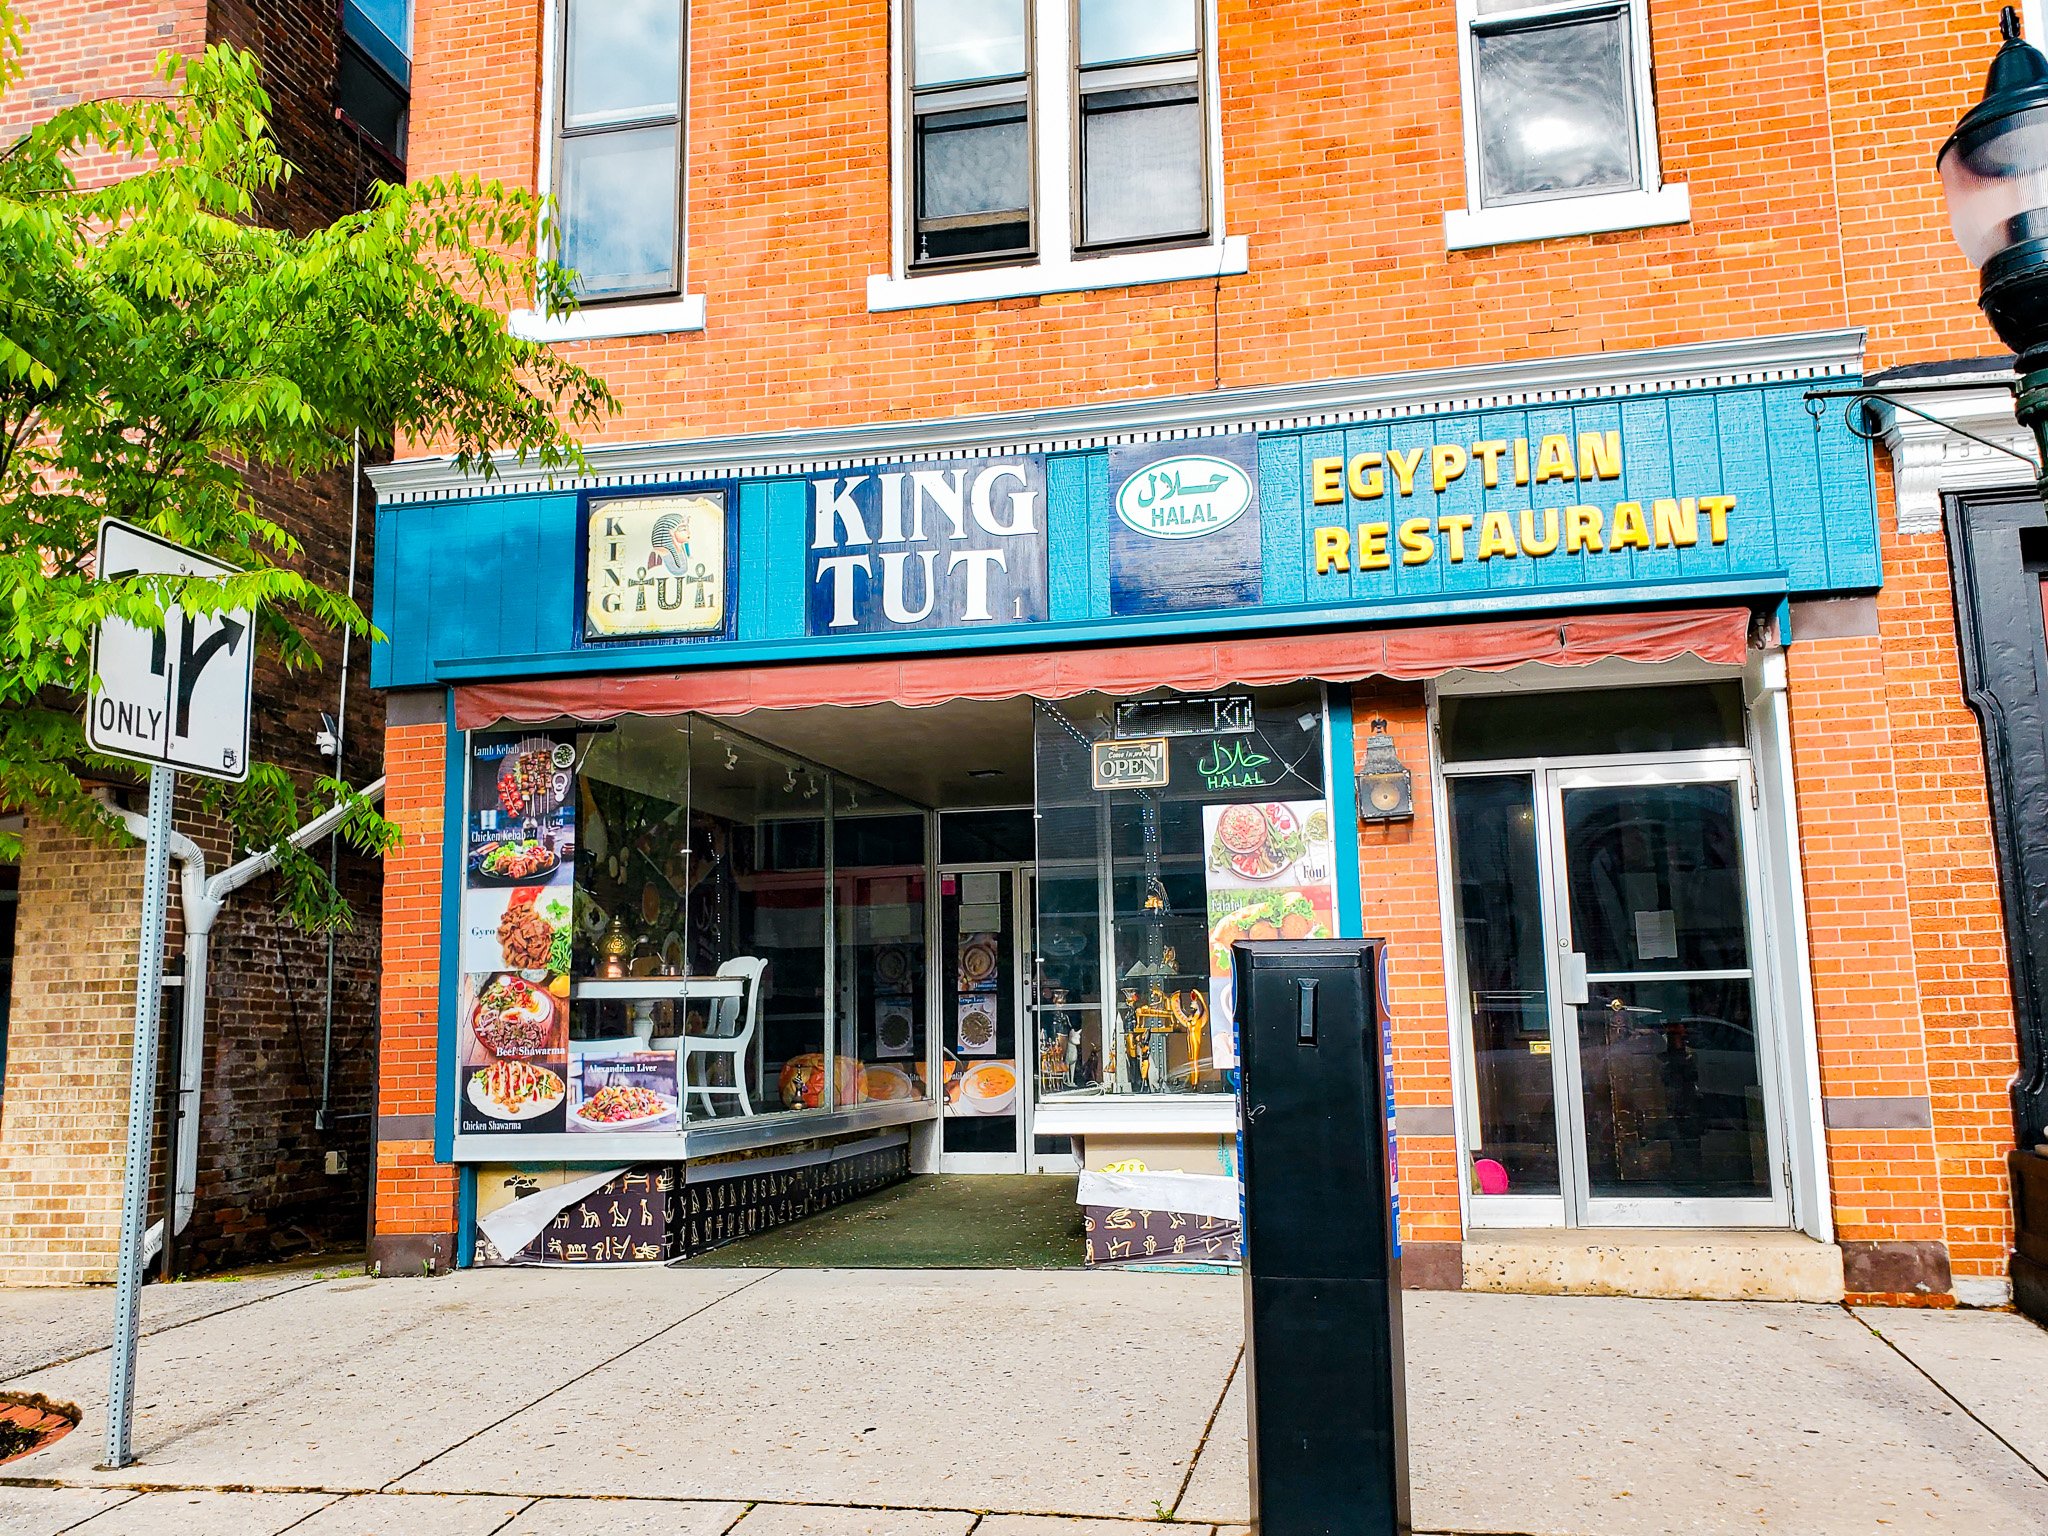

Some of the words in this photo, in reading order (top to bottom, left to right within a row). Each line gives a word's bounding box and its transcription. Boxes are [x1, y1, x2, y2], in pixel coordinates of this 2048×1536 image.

[1311, 430, 1622, 505] EGYPTIAN
[1138, 470, 1229, 508] حلال
[811, 464, 1039, 549] KING
[1151, 503, 1218, 527] HALAL
[1314, 495, 1736, 574] RESTAURANT
[601, 516, 626, 613] KING
[628, 562, 714, 612] TUT
[816, 549, 1010, 627] TUT
[1012, 596, 1023, 620] 1
[100, 697, 162, 741] ONLY
[474, 744, 494, 756] Lamb
[496, 743, 520, 755] Kebab
[1199, 740, 1268, 775] حلال
[1100, 757, 1159, 778] OPEN
[1207, 772, 1262, 789] HALAL
[471, 830, 501, 842] Chicken
[502, 828, 527, 841] Kebab
[1303, 864, 1326, 878] Foul
[471, 927, 496, 940] Gyro
[496, 1046, 517, 1057] Beef
[519, 1046, 565, 1056] Shawarma
[588, 1064, 635, 1073] Alexandrian
[637, 1063, 657, 1073] Liver
[462, 1120, 487, 1131] Chicken
[488, 1121, 522, 1131] Shawarma
